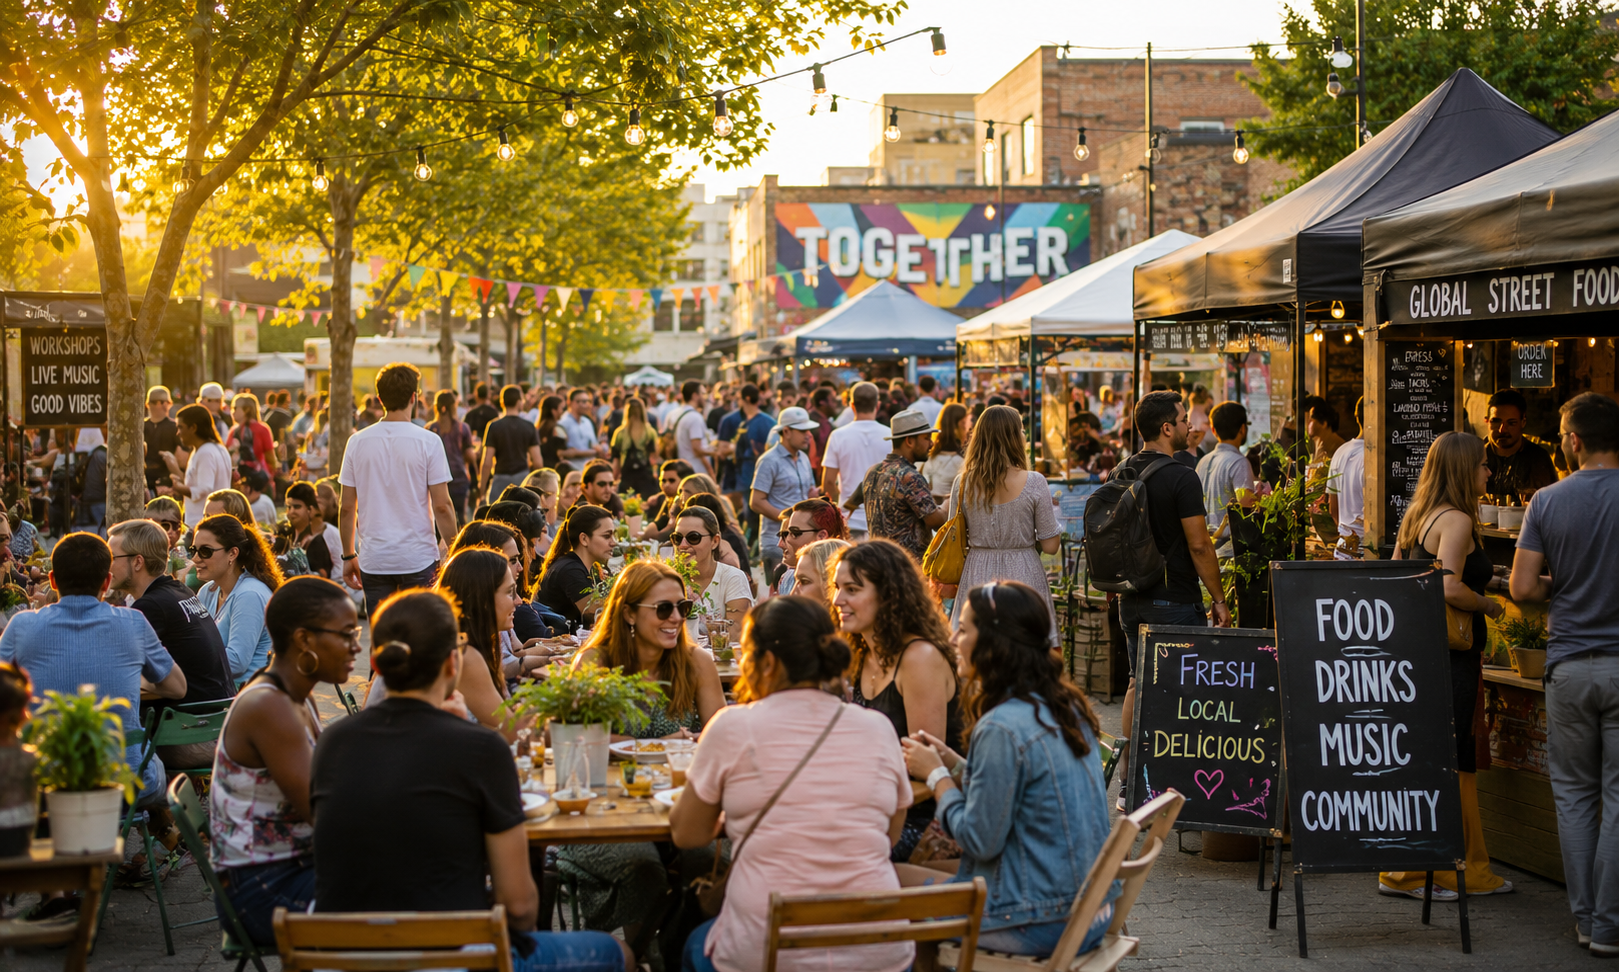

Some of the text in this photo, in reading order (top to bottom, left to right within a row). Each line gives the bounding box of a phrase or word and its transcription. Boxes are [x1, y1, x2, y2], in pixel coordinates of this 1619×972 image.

[1409, 265, 1619, 319] GLOBAL STREET FOOD
[30, 336, 101, 355] WORKSHOPS
[31, 365, 100, 385] LIVE MUSIC
[1520, 363, 1544, 379] HERE
[31, 394, 102, 414] GOOD VIBES
[1315, 598, 1395, 642] FOOD
[1180, 653, 1255, 689] FRESH
[1315, 659, 1417, 703] DRINKS
[1177, 697, 1241, 723] LOCAL
[1153, 729, 1266, 764] DELICIOUS
[1319, 722, 1411, 767] MUSIC
[1300, 787, 1440, 832] COMMUNITY
